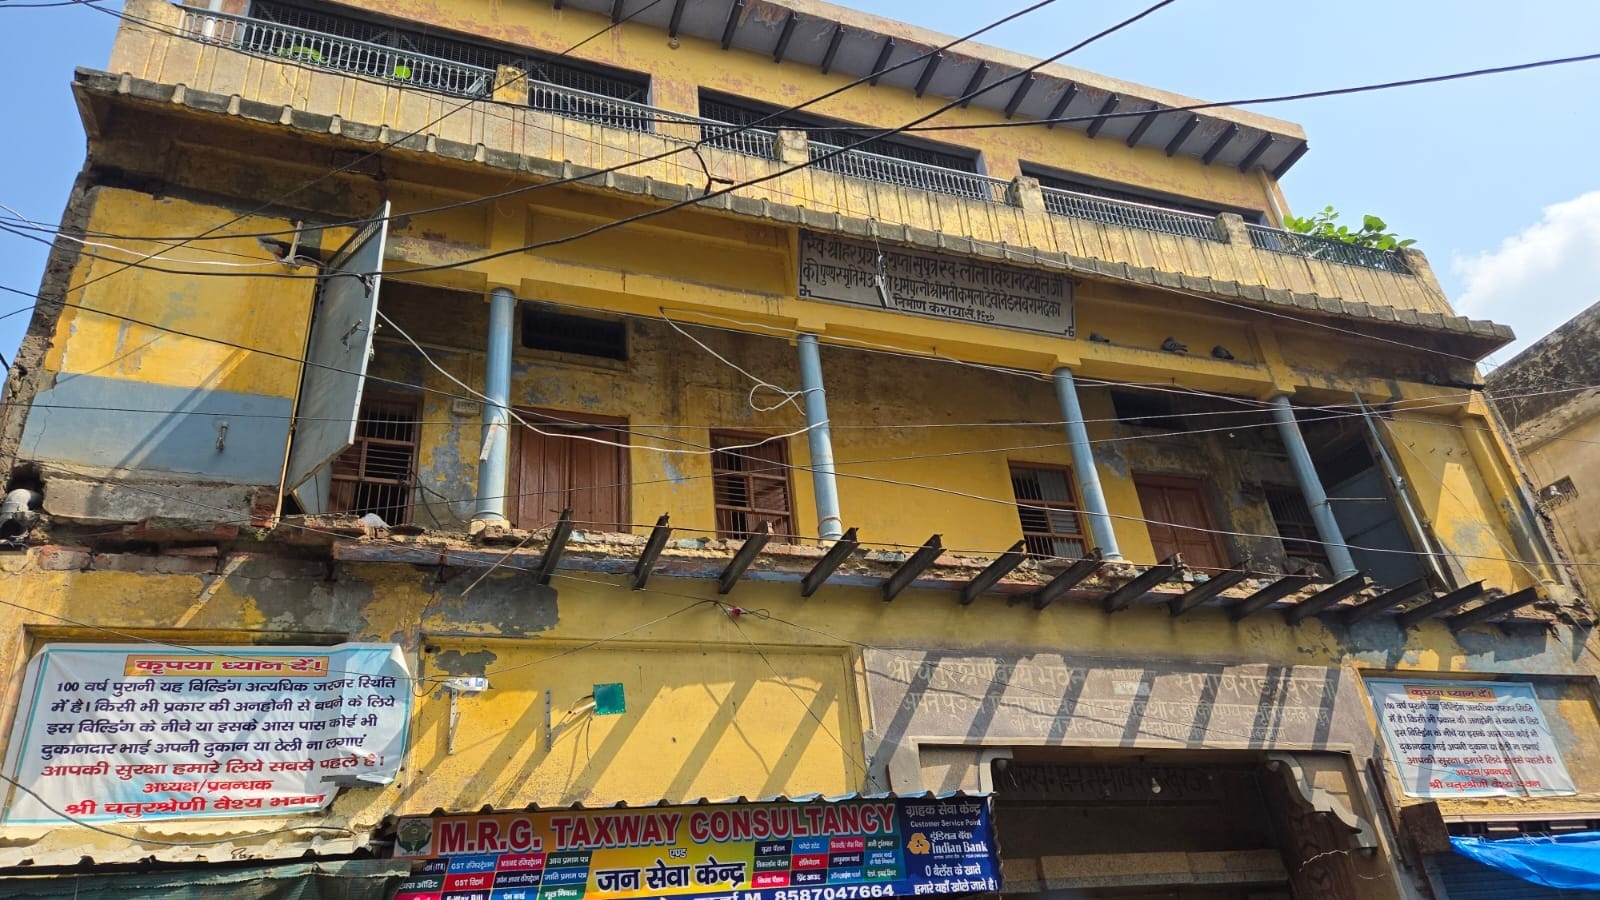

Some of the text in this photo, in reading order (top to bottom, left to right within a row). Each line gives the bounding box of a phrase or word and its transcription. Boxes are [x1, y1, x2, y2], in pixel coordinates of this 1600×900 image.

[135, 660, 214, 675] कृपया
[222, 661, 282, 671] ध्यान
[57, 682, 79, 692] 100
[85, 679, 110, 692] वर्ष
[113, 679, 155, 696] पुरानी
[160, 682, 182, 692] यह
[189, 678, 240, 692] बिल्डिंग
[245, 679, 309, 692] अत्यधिक
[358, 676, 396, 688] स्थिति
[1411, 688, 1444, 698] कृपया
[51, 699, 68, 712] में
[95, 699, 135, 712] किसी
[140, 699, 159, 711] भी
[164, 702, 205, 713] प्रकार
[209, 699, 230, 711] की
[234, 698, 292, 712] अनहोनी
[297, 699, 311, 710] से
[348, 695, 363, 707] के
[367, 695, 395, 707] लिये
[46, 713, 378, 735] इस बिल्डिंग के नीचे या इसके आस पास कोई भी
[41, 734, 367, 760] दुकानदार भाई अपनी दुकान या ठेली ना लगाएं
[41, 754, 359, 780] आपकी सुरक्षा हमारे लिये सबसे पहले
[65, 799, 97, 815] श्री
[214, 795, 262, 810] वैश्य
[270, 794, 326, 807] भवन
[905, 801, 981, 818] ग्राहक सेवा केन्द्र
[438, 803, 896, 855] M.R.G. TAXWAY CONSULTANCY
[932, 841, 988, 854] Indian Bank
[595, 856, 747, 892] जन सेवा केन्द्र
[955, 864, 962, 875] के
[964, 862, 981, 875] खाते
[914, 880, 934, 895] हमारे
[951, 880, 969, 892] खोले
[971, 878, 987, 890] जाते
